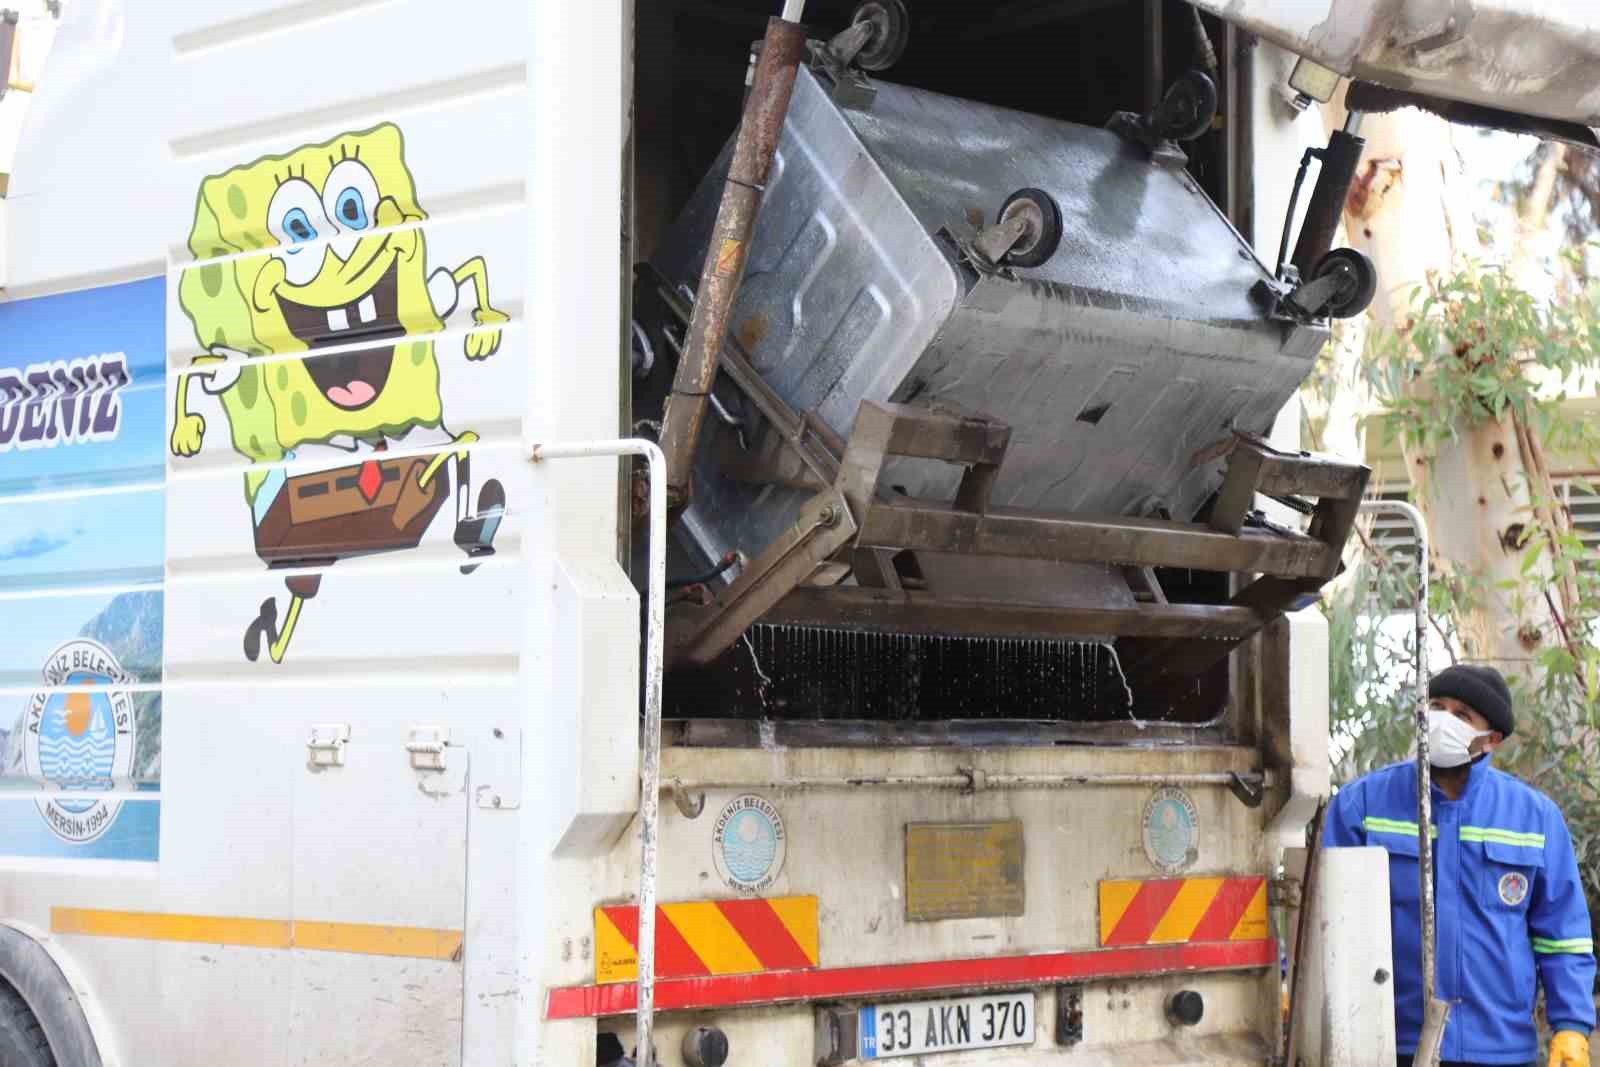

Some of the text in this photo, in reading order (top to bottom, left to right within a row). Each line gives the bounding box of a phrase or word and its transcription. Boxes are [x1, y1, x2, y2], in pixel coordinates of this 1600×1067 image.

[29, 654, 69, 734] AKDNİZ
[863, 1001, 1026, 1051] TR 33 AKN 370
